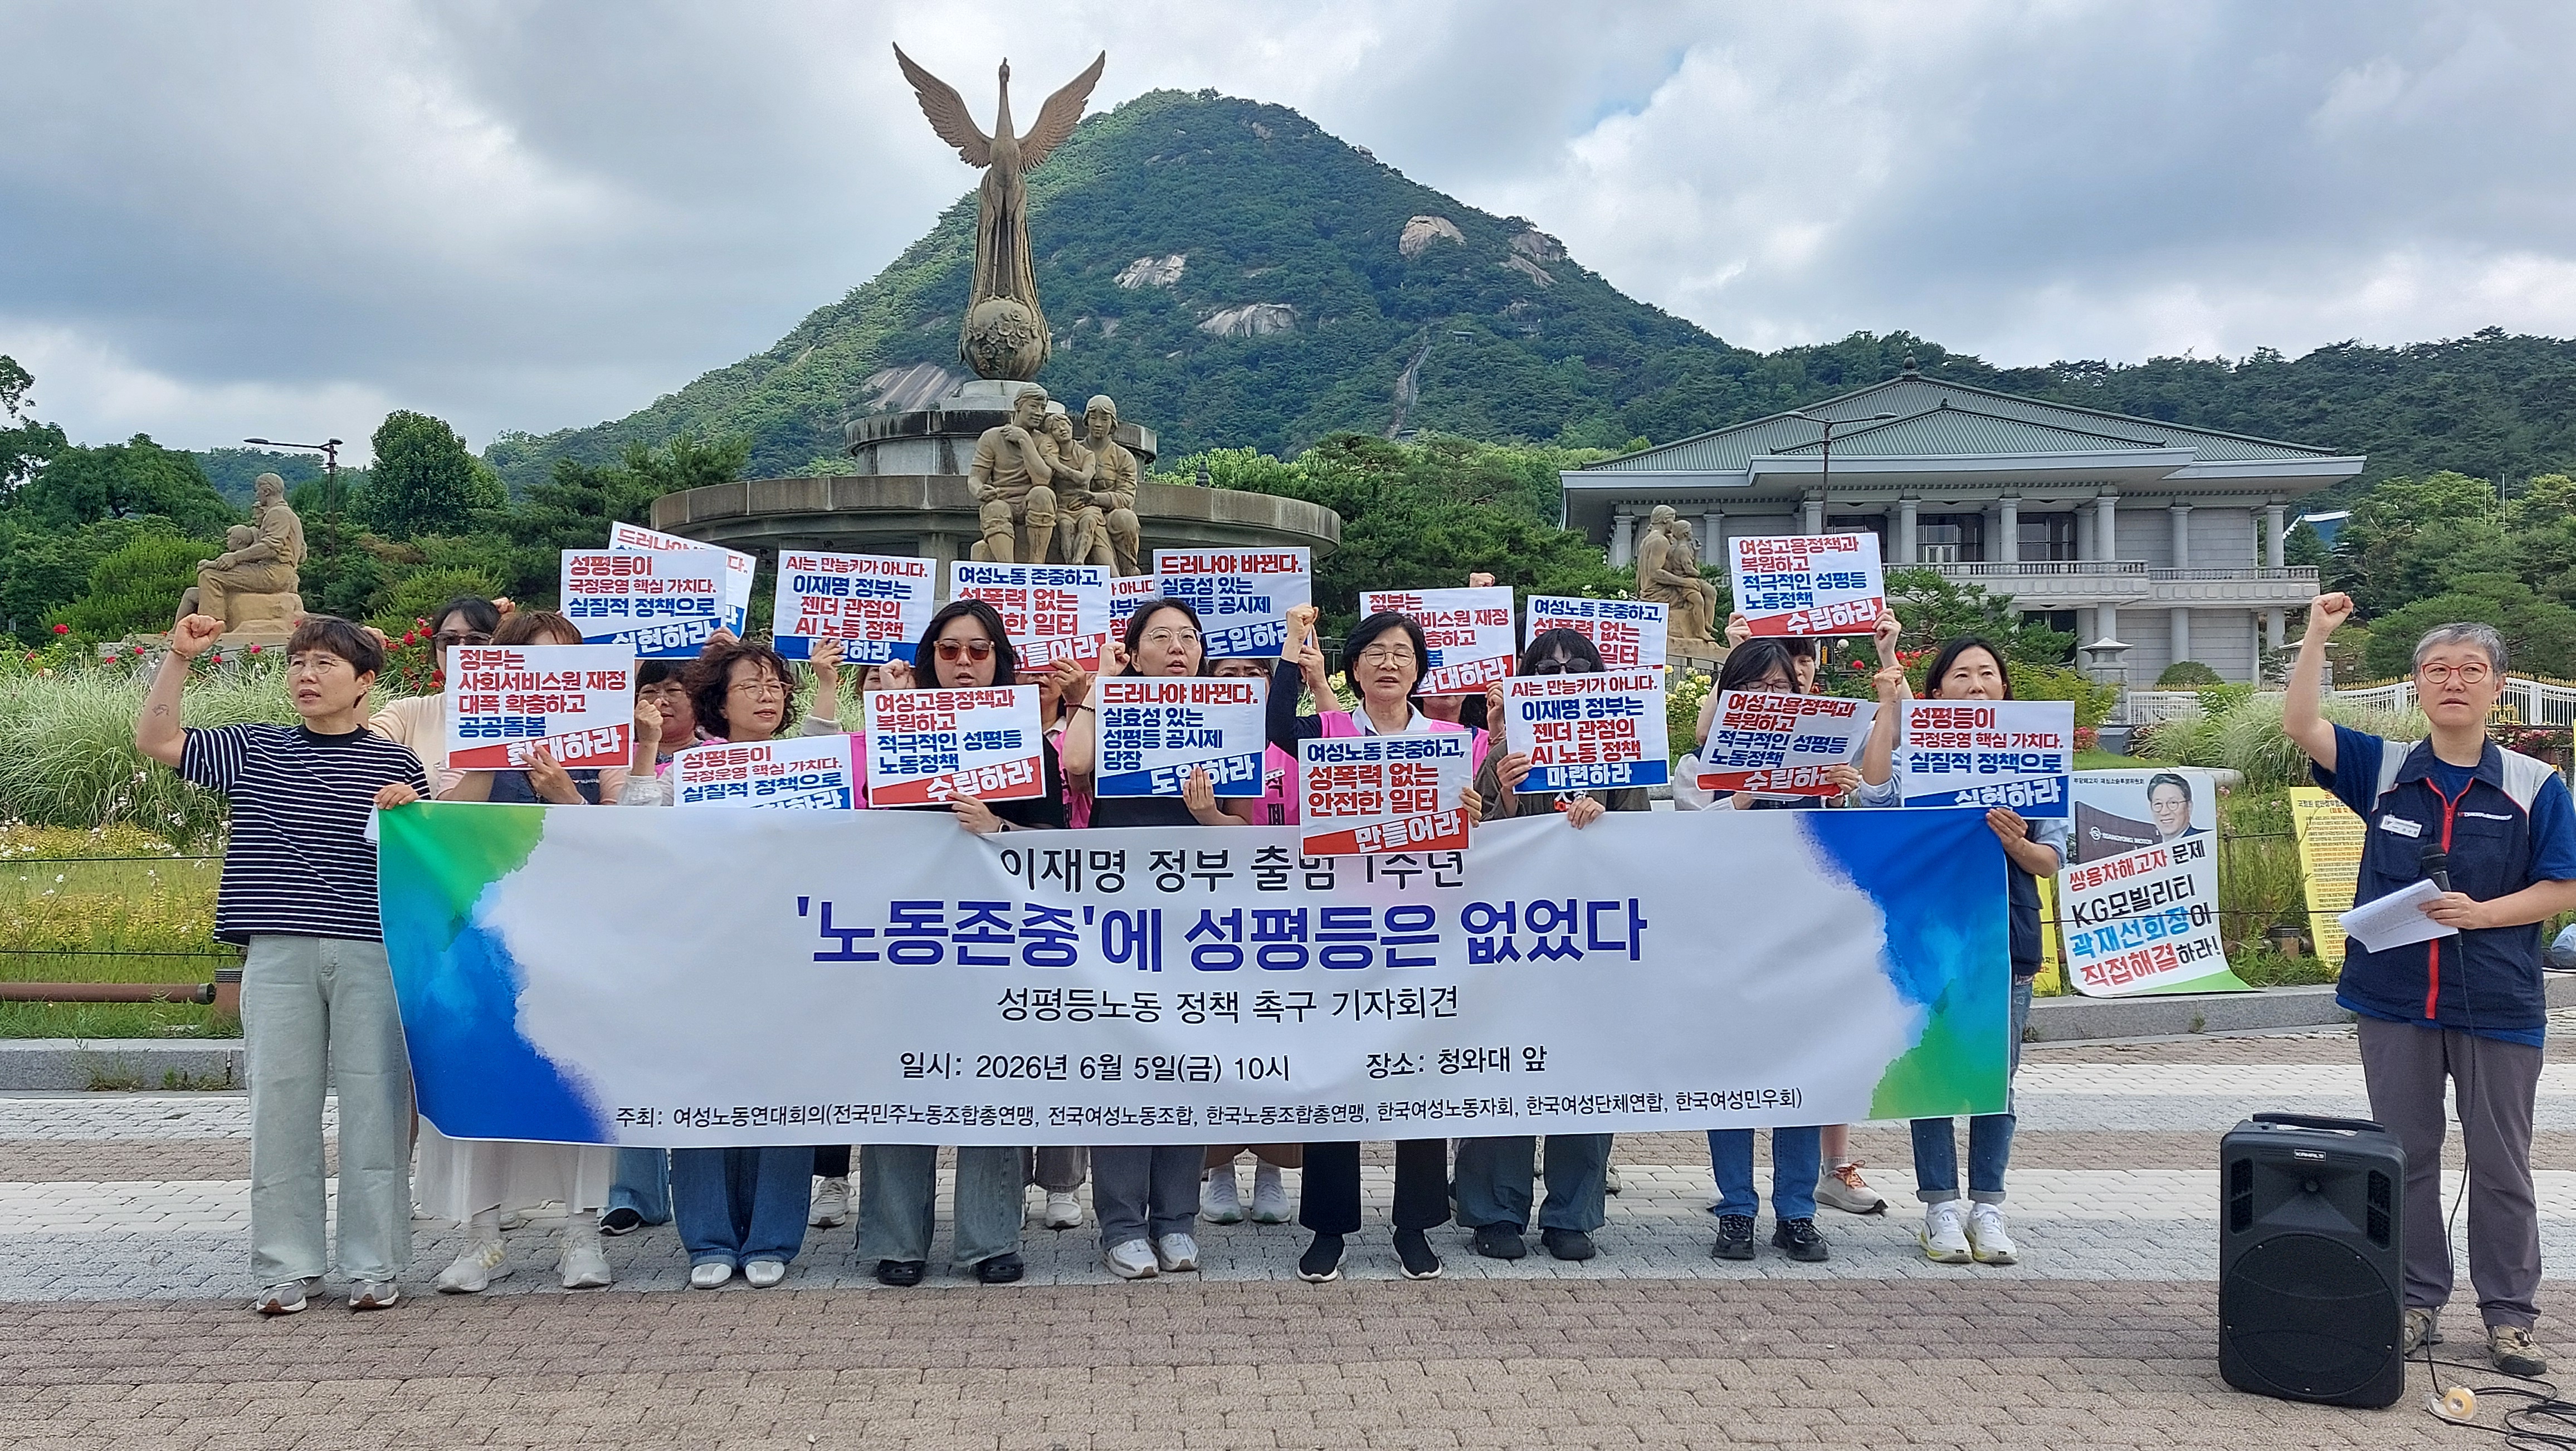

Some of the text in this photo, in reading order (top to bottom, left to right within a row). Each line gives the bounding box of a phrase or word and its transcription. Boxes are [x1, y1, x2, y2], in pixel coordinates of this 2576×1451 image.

[1739, 536, 1859, 554] 여성고용정책과
[569, 556, 652, 576] 성평등이
[786, 556, 928, 577] AI는 만능키가 아니다.
[1161, 554, 1302, 574] 드러나야 바뀐다.
[1741, 556, 1810, 573] 복원하고
[569, 579, 716, 594] 국정운영 핵심 가치다.
[793, 575, 912, 600] 이재명 정부는
[959, 567, 1102, 587] 여성노동 존중하고,
[1161, 577, 1253, 596] 실효성 있는
[1743, 572, 1867, 591] 적극적인 성평등
[568, 598, 629, 617] 실질적
[635, 597, 715, 617] 정책으로
[801, 596, 900, 620] 젠더 관점의
[1033, 589, 1078, 612] 없는
[1218, 596, 1271, 614] 공시제
[1369, 594, 1422, 612] 정부는
[1746, 592, 1814, 610] 노동정책
[1475, 609, 1508, 625] 재정
[1535, 600, 1662, 623] 여성노동 존중하고,
[1788, 600, 1877, 635] 수립하라
[794, 617, 904, 641] AI 노동 정책
[1033, 613, 1077, 636] 일터
[1599, 621, 1640, 642] 없는
[1426, 631, 1476, 647] 충하고
[459, 650, 525, 670] 정부는
[1016, 635, 1100, 668] 들어라
[1599, 645, 1638, 665] 일터
[458, 671, 626, 692] 사회서비스원 재정
[1511, 675, 1657, 696] AI는 만능키가 아니다.
[459, 694, 586, 714] 대폭 확충하고
[876, 690, 1014, 713] 여성고용정책과
[1104, 683, 1258, 704] 드러나야 바뀐다.
[1523, 697, 1644, 720] 이재명 정부는
[1728, 694, 1857, 718] 여성고용정책과
[459, 716, 546, 737] 공공돌봄
[876, 713, 957, 733] 복원하고
[1103, 708, 1204, 727] 실효성 있는
[1723, 712, 1796, 732] 복원하고
[1910, 708, 1995, 728] 성평등이
[878, 730, 1022, 753] 적극적인 성평등
[1103, 729, 1223, 749] 성평등 공시제
[1533, 719, 1635, 743] 젠더 관점의
[1910, 733, 2063, 748] 국정운영 핵심 가치다.
[1308, 739, 1465, 762] 여성노동 존중하고,
[1718, 730, 1848, 754] 적극적인 성평등
[682, 746, 770, 769] 성평등이
[1104, 751, 1142, 770] 당장
[1531, 741, 1641, 765] AI 노동 정책
[1709, 749, 1784, 768] 노동정책
[1910, 752, 2062, 773] 실질적 정책으로
[682, 758, 842, 783] 국정운영 핵심 가치다.
[879, 754, 959, 775] 노동정책
[926, 760, 1034, 801] 수립하라
[1309, 763, 1438, 790] 성폭력 없는
[1547, 764, 1632, 788] 마련하라
[682, 772, 842, 803] 실질적 정책으로
[1309, 791, 1383, 816] 안전한
[1389, 788, 1438, 814] 일터
[1354, 811, 1461, 853] 만들어라
[1001, 845, 1463, 892] 이재명 정부 출범 1주년
[2069, 840, 2206, 892] 쌍용차해고자 문제
[2071, 874, 2196, 928] KG모빌리티
[797, 896, 1647, 972] '노동존중'에 성평등은 없었다
[2070, 903, 2212, 958] 곽재선회장이
[997, 985, 1458, 1024] 성평등노동 정책 촉구 기자회견
[900, 1046, 1548, 1082] 일시: 2026년 6월 5일(금) 10시 장소: 청와대 앞
[616, 1088, 1803, 1128] 주최: 여성노동연대회의(전국민주노동조합총연맹, 전국여성노동조합, 한국노동조합총연맹, 한국여성노동자회, 한국여성단체연합, 한국여성민우회)
